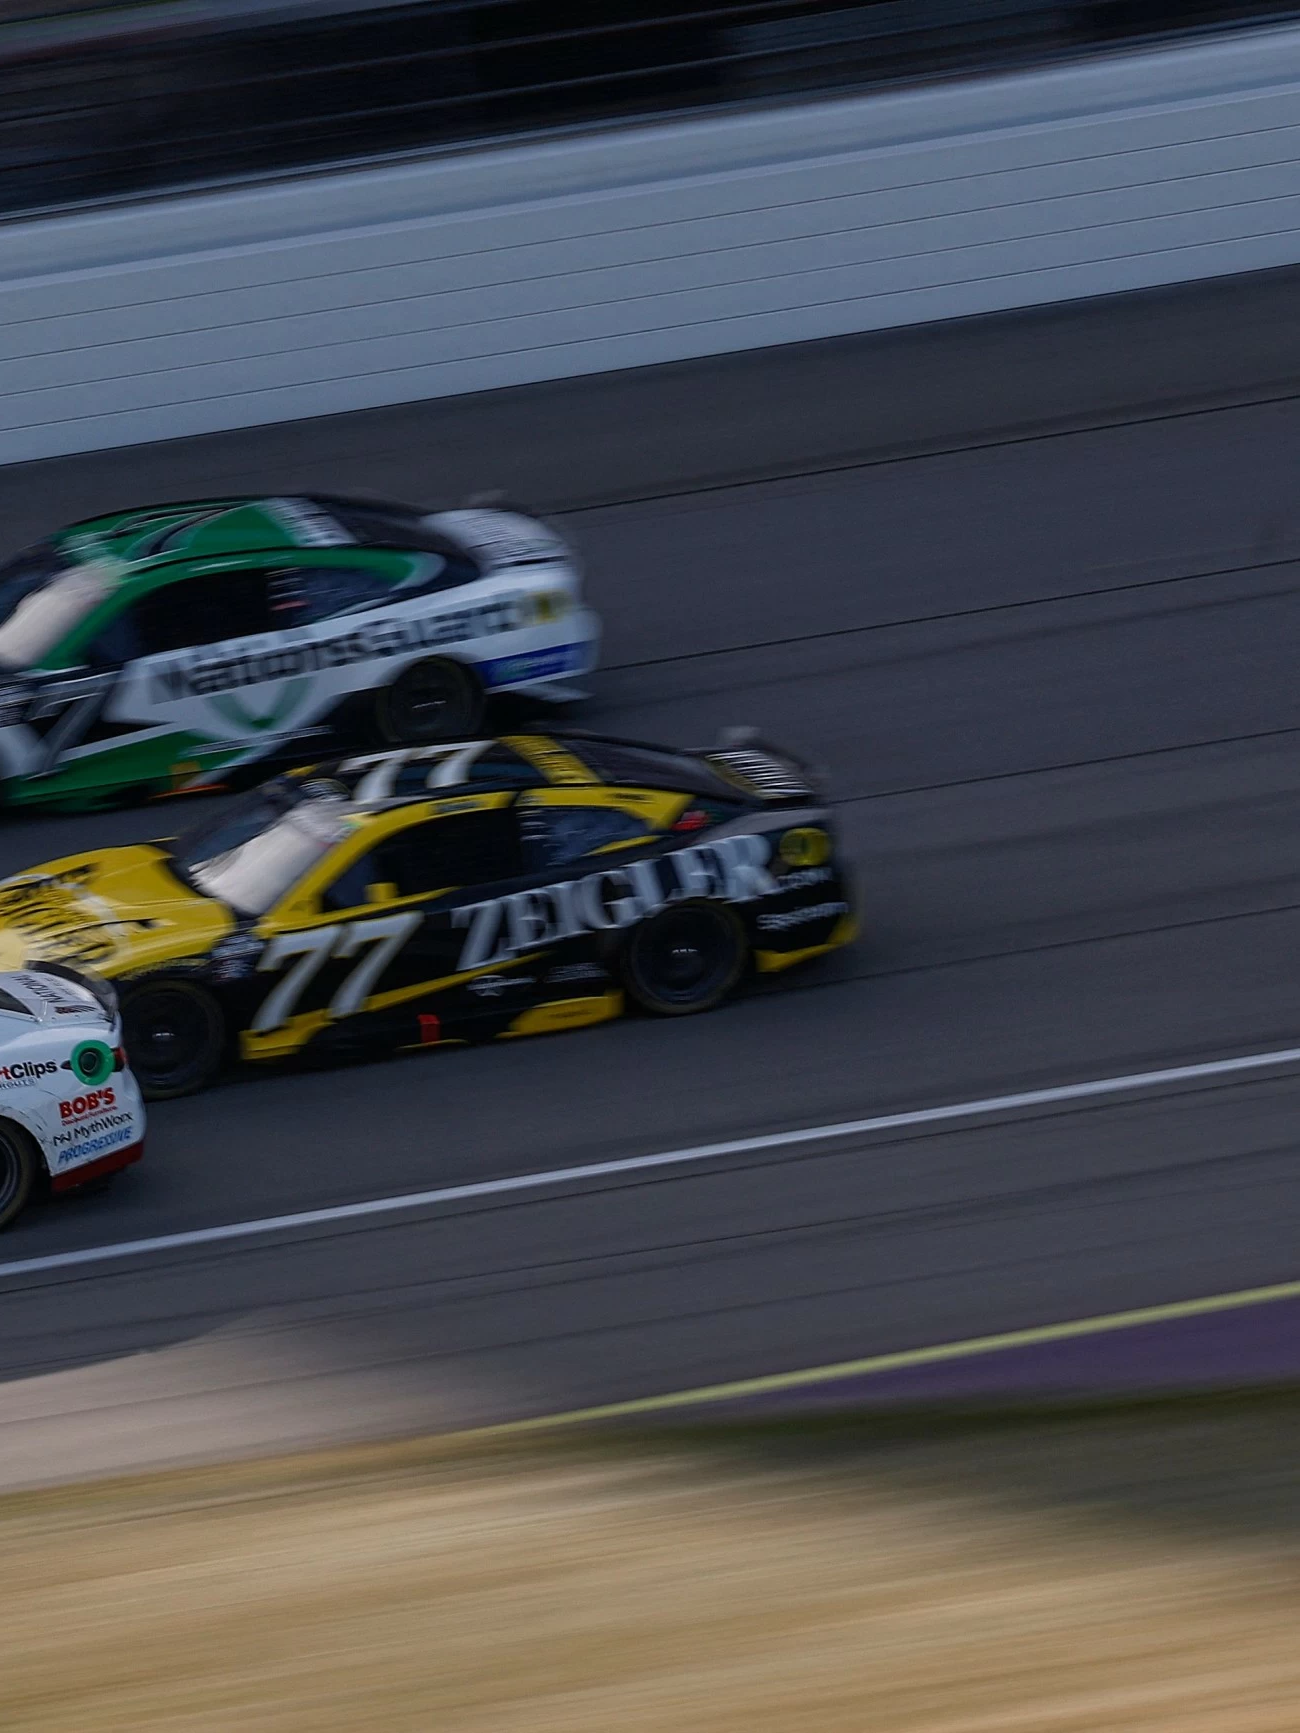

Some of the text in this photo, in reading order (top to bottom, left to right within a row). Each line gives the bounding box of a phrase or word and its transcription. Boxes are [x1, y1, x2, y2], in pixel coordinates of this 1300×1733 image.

[338, 739, 497, 803] 77
[450, 833, 780, 971] ZEIGLER
[256, 911, 425, 1034] 77
[59, 1087, 116, 1119] BOB'S
[57, 1126, 133, 1164] PROGRESSIVE
